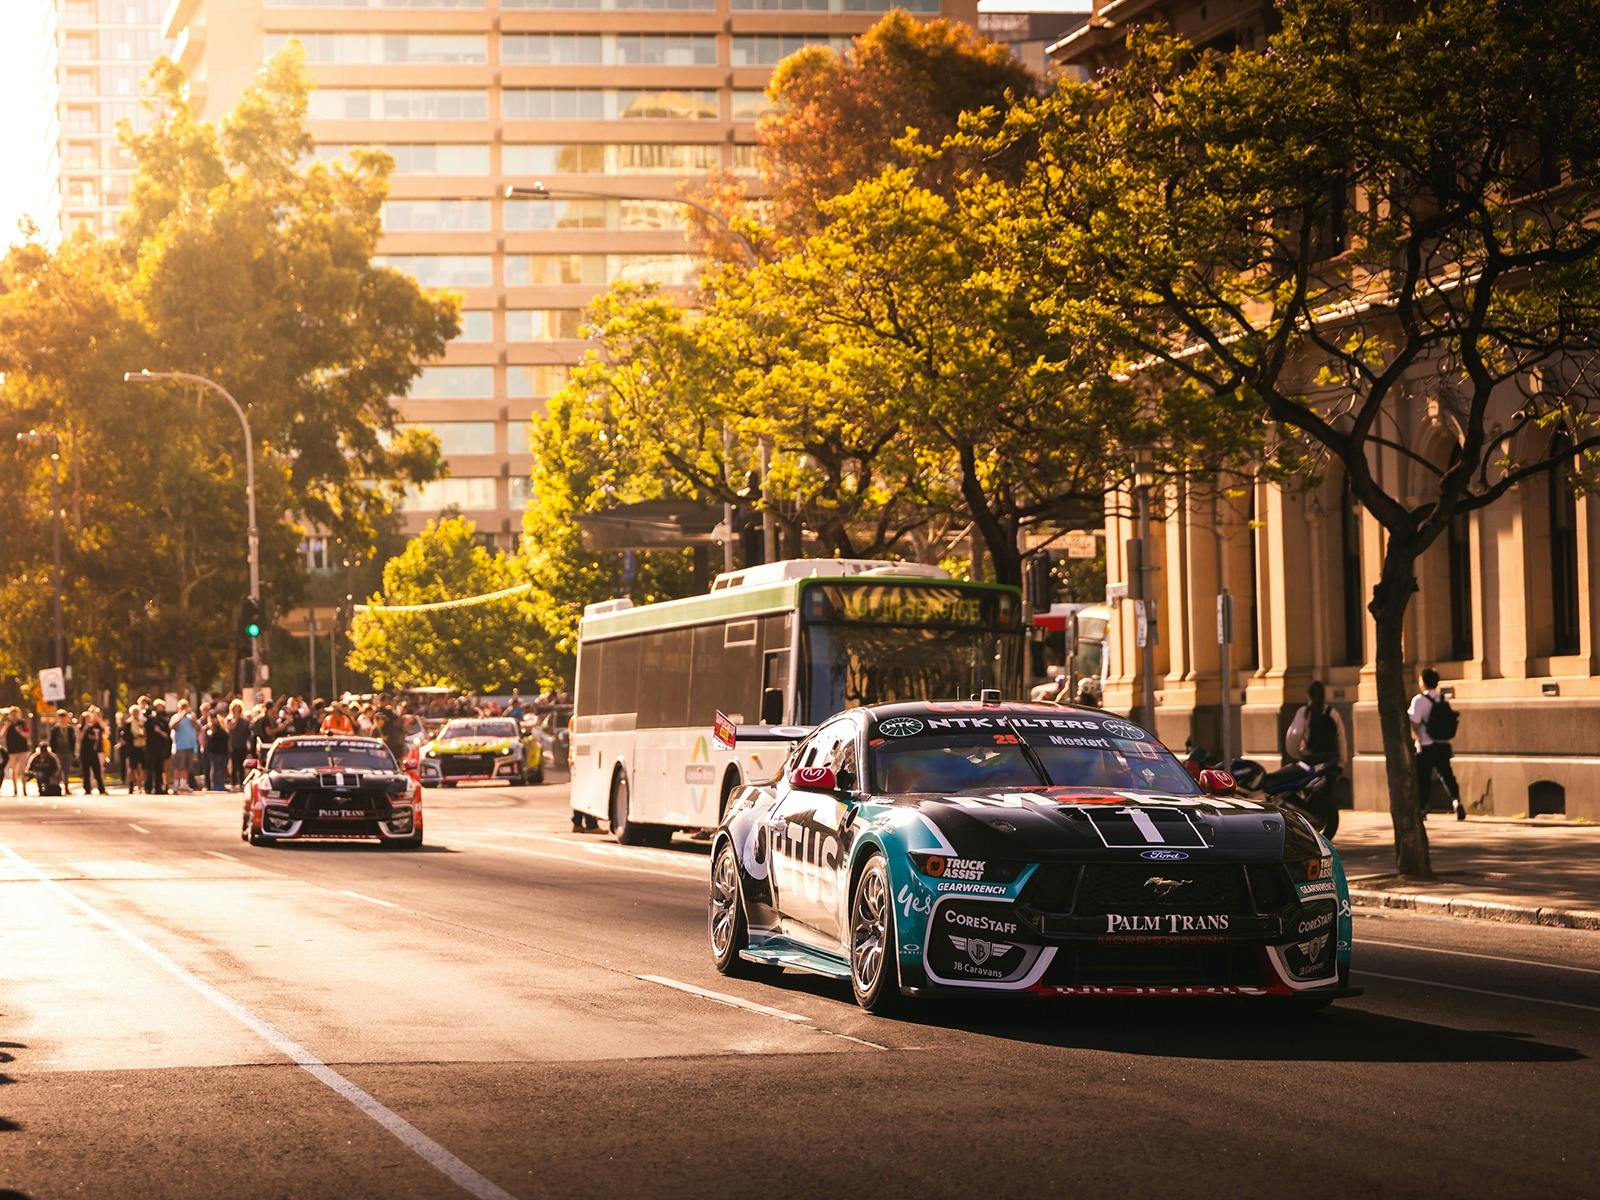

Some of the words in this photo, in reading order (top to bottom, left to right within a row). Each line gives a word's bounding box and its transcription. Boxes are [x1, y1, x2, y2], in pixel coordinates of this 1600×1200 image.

[885, 720, 915, 729] NTK
[928, 718, 993, 730] NTK
[998, 717, 1100, 731] FILTERS
[297, 740, 338, 748] TRUCK
[993, 734, 1018, 746] 25
[1050, 735, 1111, 749] Mostert
[1150, 850, 1182, 860] Ford
[946, 858, 986, 871] TRUCK
[942, 869, 984, 881] ASSIST
[937, 882, 1007, 894] GEARWRENCH
[1106, 913, 1161, 933] PALM
[1165, 914, 1229, 933] TRANS
[953, 961, 963, 971] JB
[964, 963, 1003, 978] Caravans
